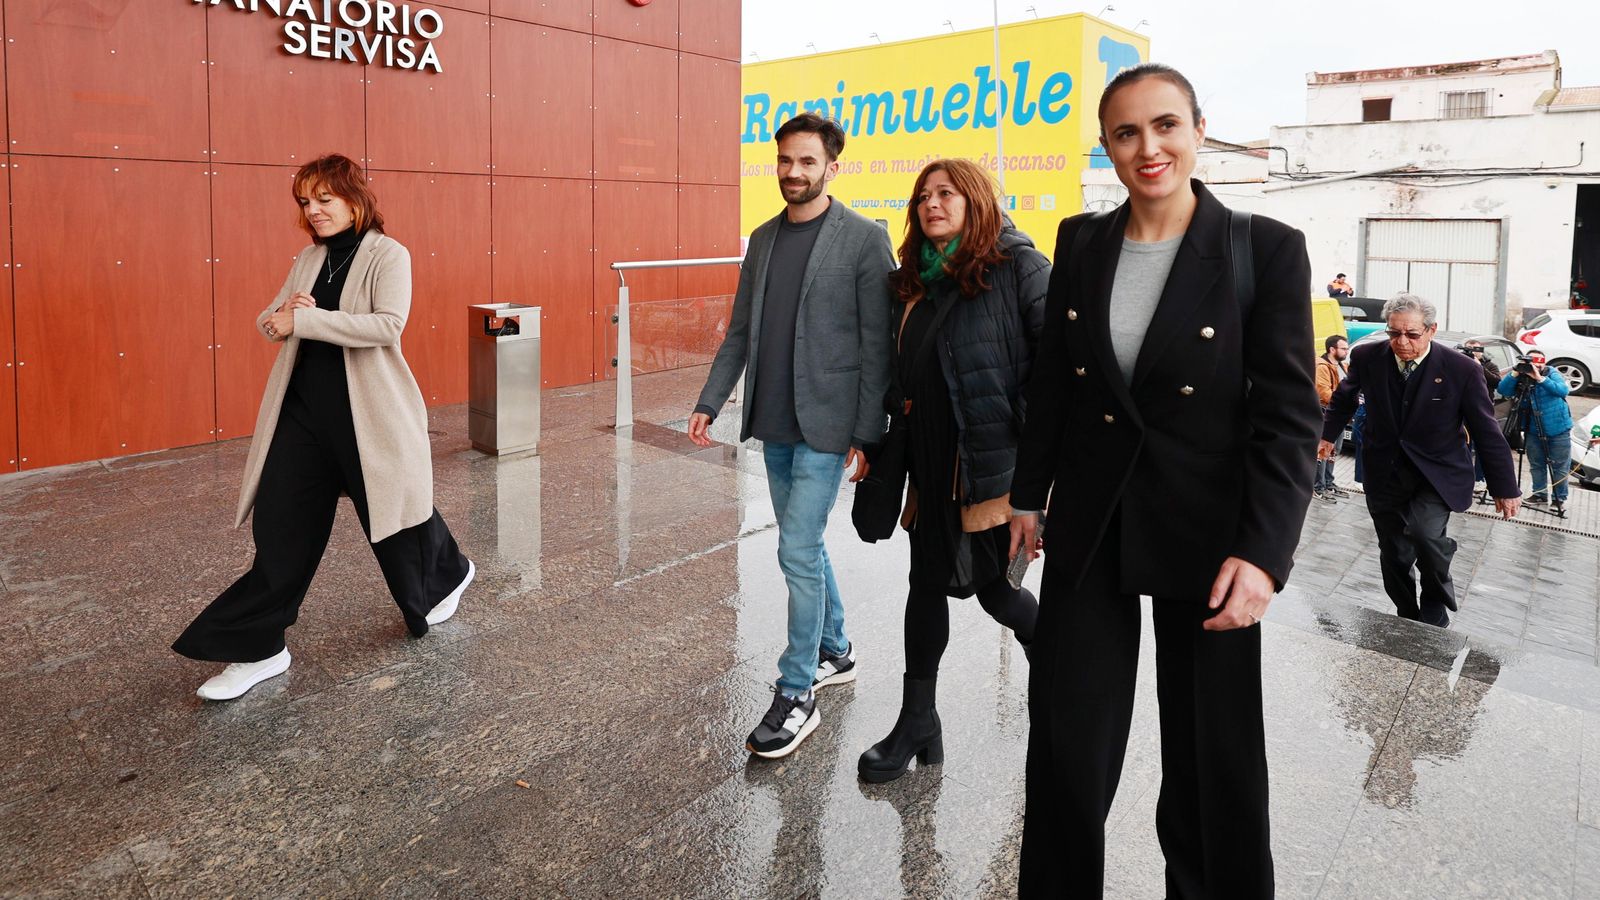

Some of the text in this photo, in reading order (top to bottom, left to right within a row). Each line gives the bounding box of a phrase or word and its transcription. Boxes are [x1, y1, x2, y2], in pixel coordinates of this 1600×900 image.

[283, 20, 443, 73] SERVISA
[870, 159, 888, 174] en
[979, 152, 1067, 171] descanso
